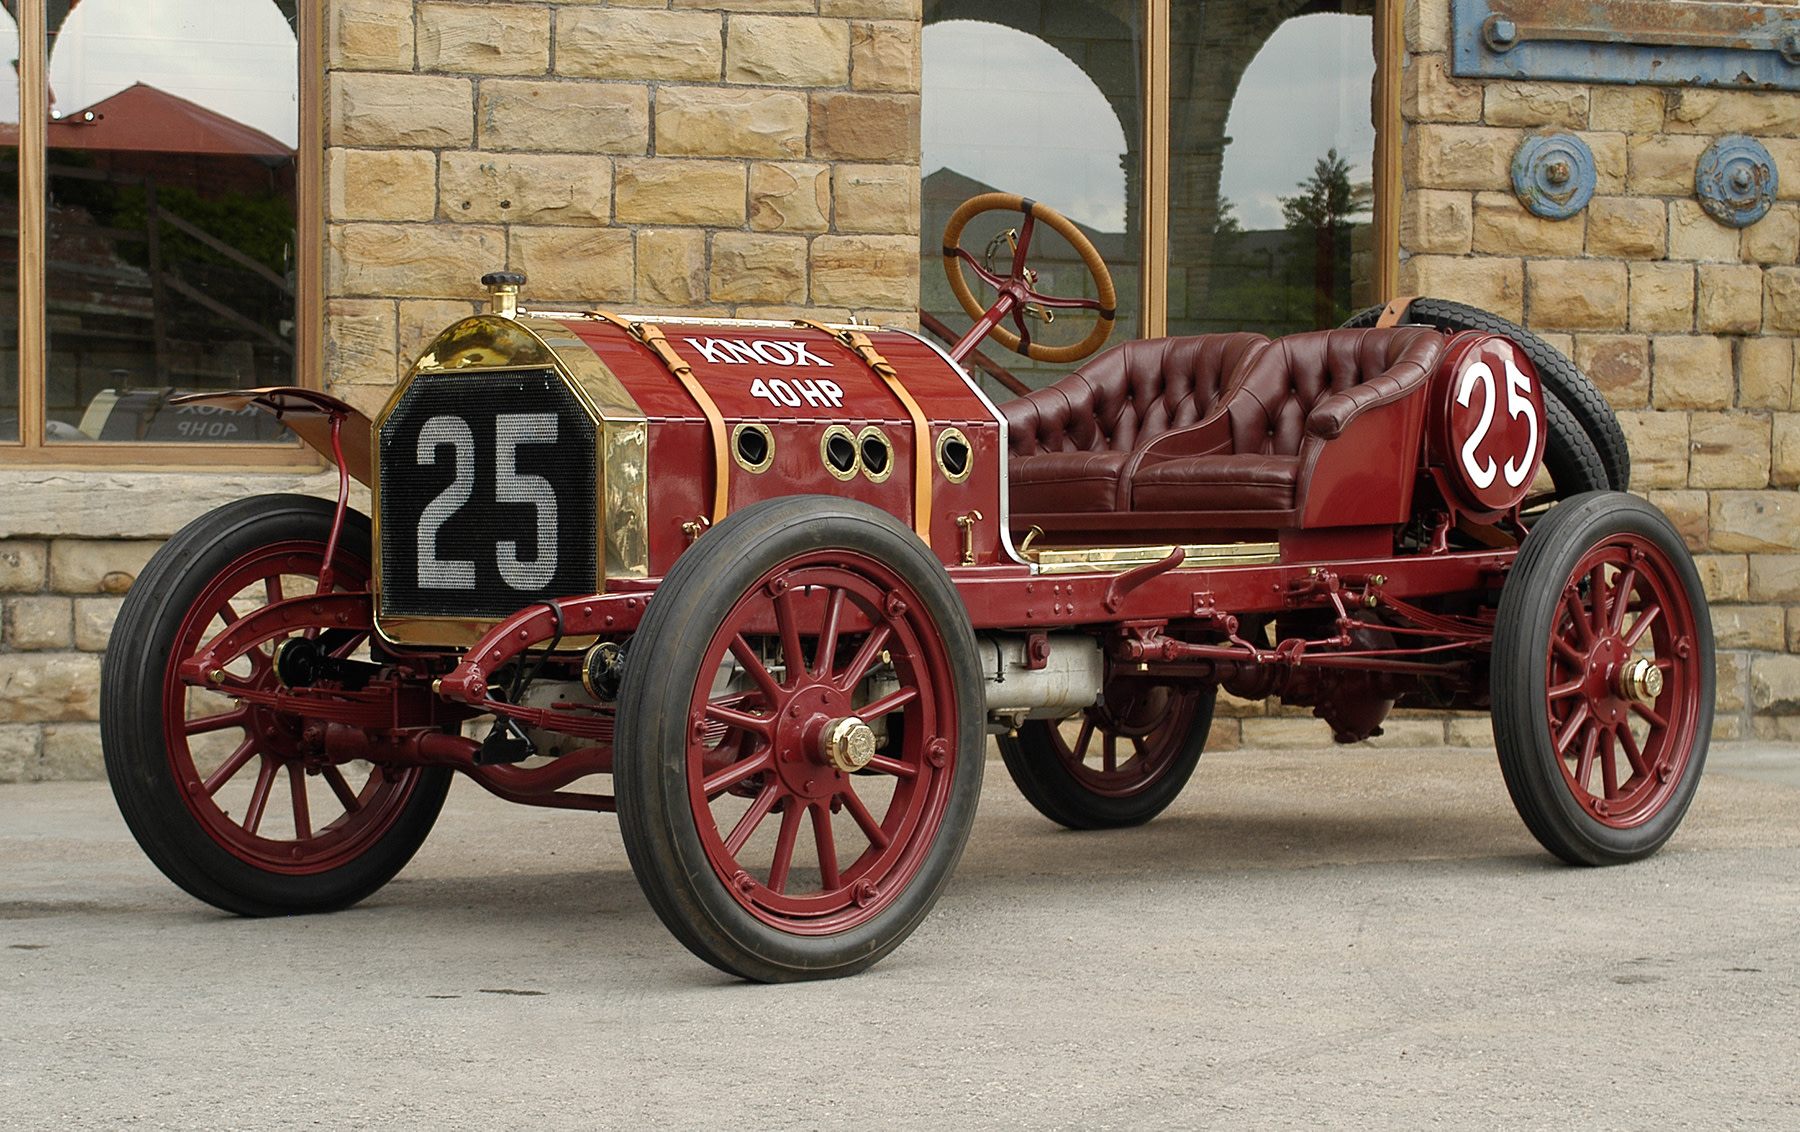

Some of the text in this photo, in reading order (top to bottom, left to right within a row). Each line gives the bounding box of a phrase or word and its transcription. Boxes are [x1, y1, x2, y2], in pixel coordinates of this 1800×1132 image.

[683, 337, 834, 366] KNOX
[750, 378, 844, 408] 40 HP
[1456, 359, 1538, 489] 25
[417, 413, 559, 591] 25
